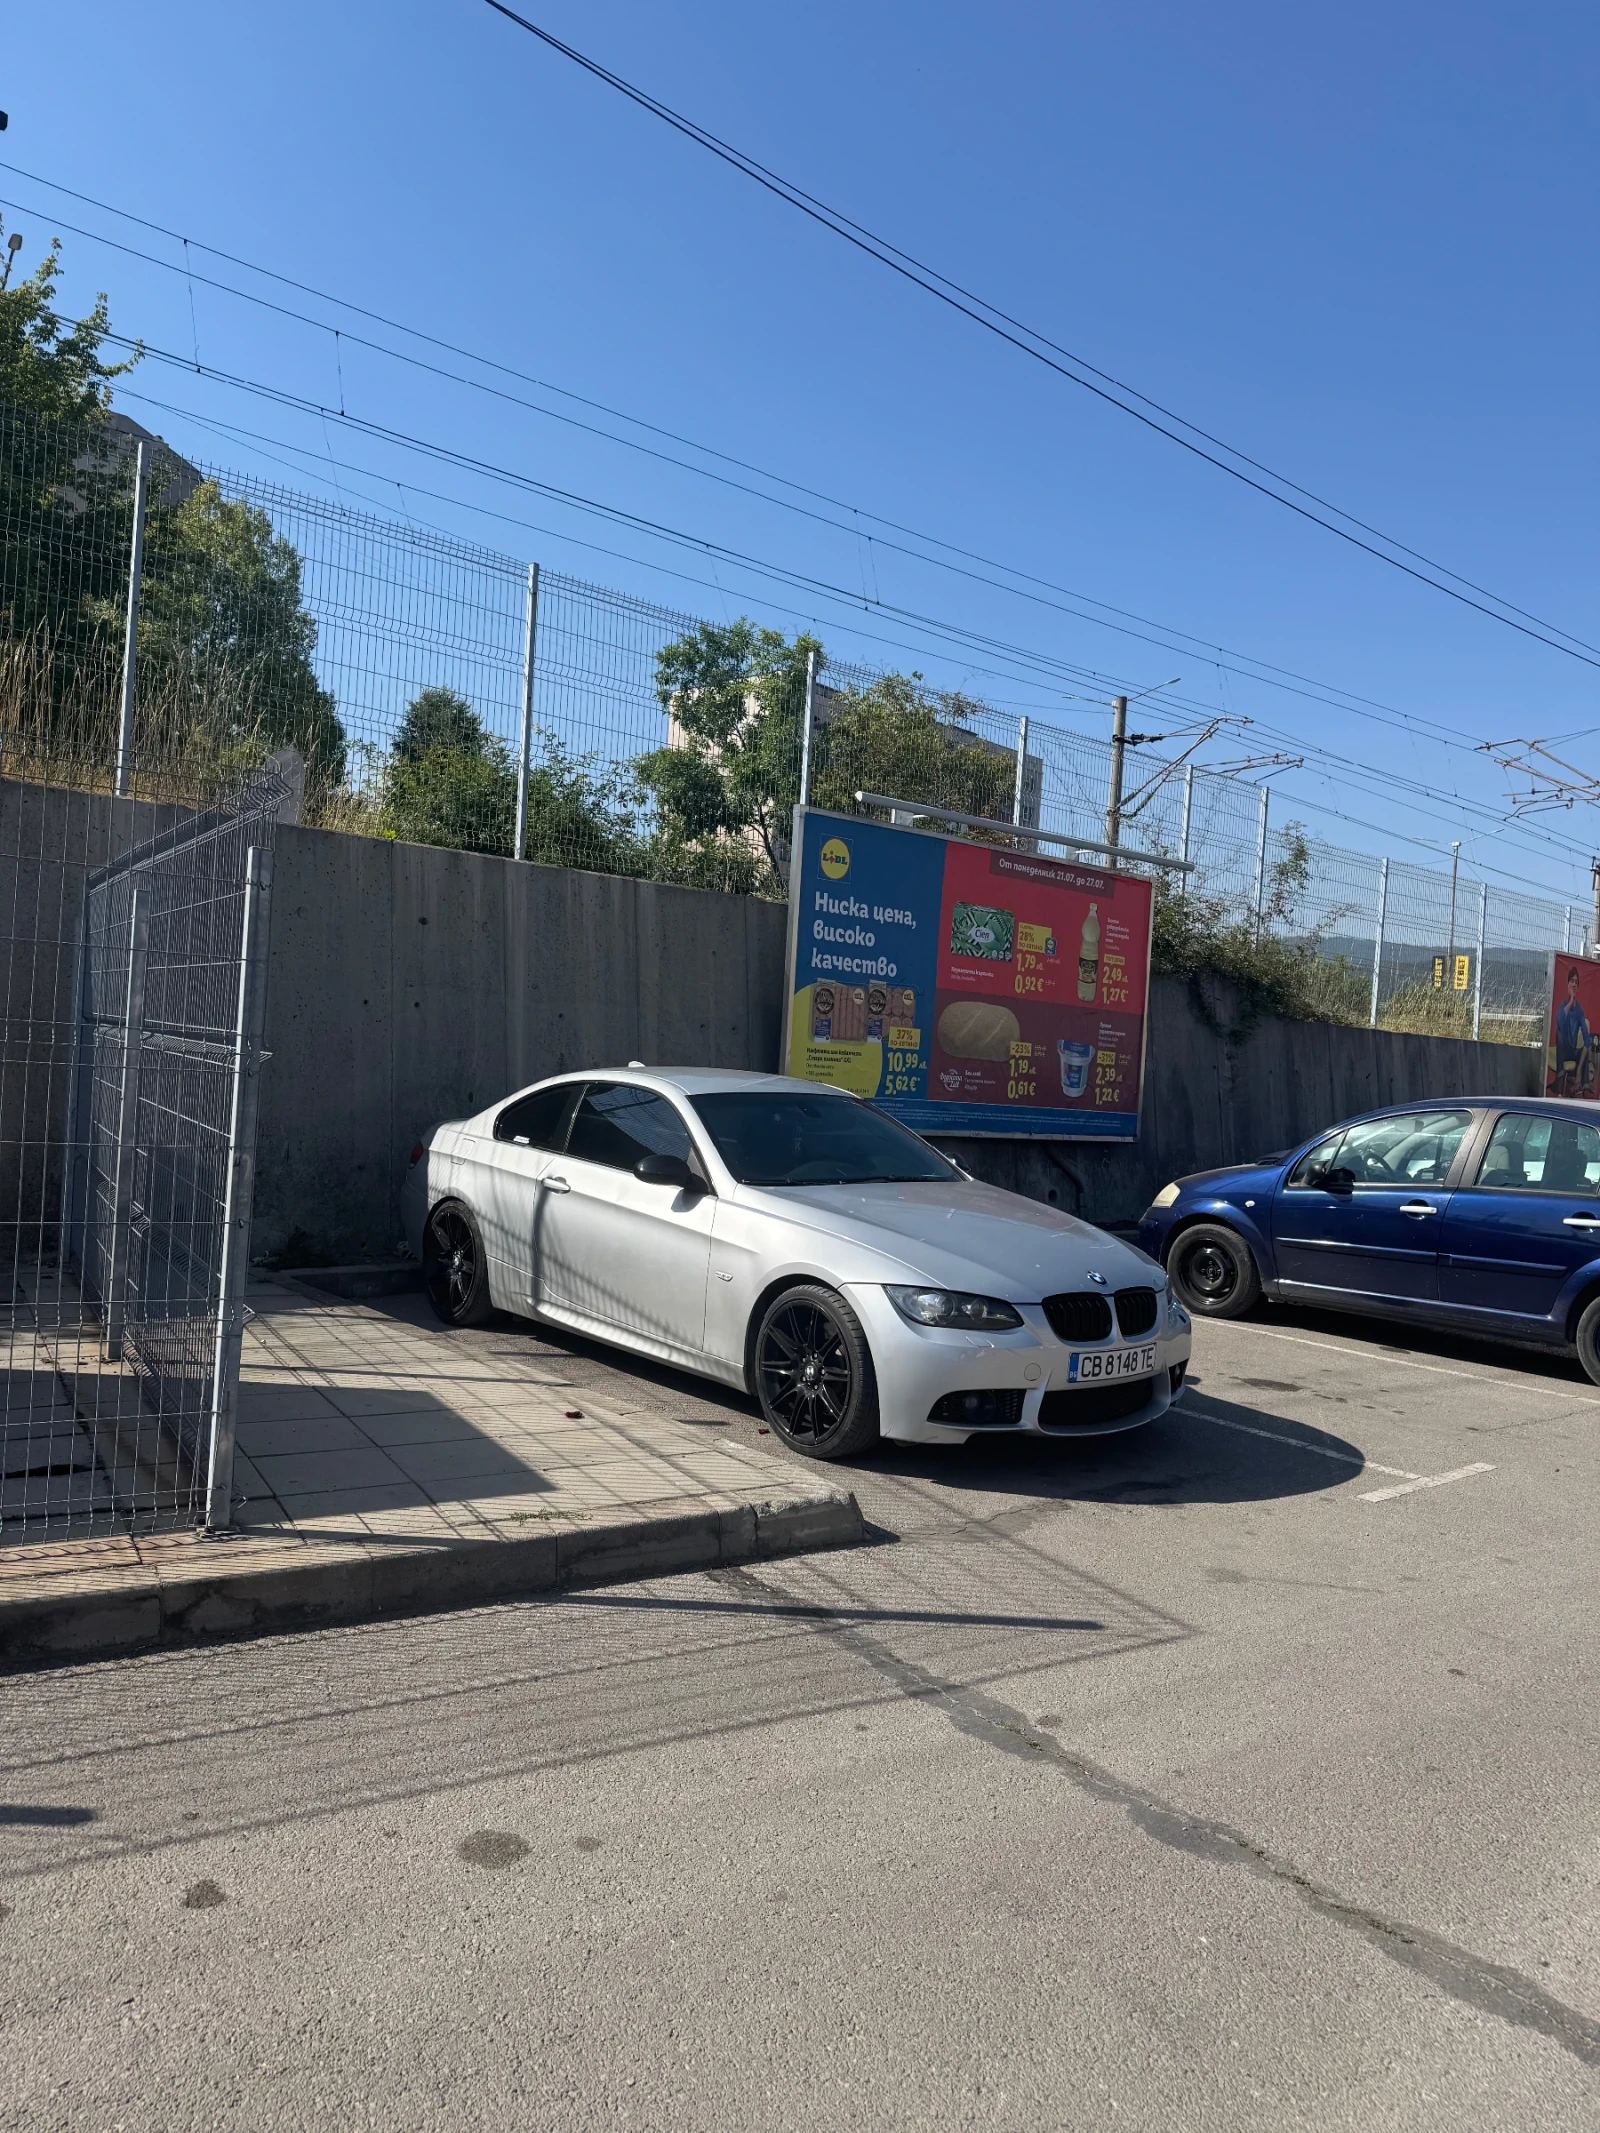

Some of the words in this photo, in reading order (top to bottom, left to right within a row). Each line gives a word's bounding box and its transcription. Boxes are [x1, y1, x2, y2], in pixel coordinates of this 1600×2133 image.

[999, 858, 1012, 870] От
[1013, 862, 1056, 879] понеделник
[1057, 871, 1076, 883] 21.07.
[1076, 875, 1085, 886] до
[1086, 877, 1105, 890] 27.07.
[815, 891, 869, 919] Ниска
[873, 905, 917, 929] цена,
[813, 919, 875, 947] високо
[974, 928, 990, 939] Cien
[1019, 931, 1034, 942] 28%
[811, 947, 897, 977] качество
[889, 1040, 918, 1048] ПО-ЕВТИНО
[896, 1029, 914, 1040] 37%
[1012, 1043, 1030, 1055] -23%
[1081, 1356, 1102, 1377] CB
[1105, 1351, 1138, 1375] 8148
[1140, 1347, 1154, 1369] TE
